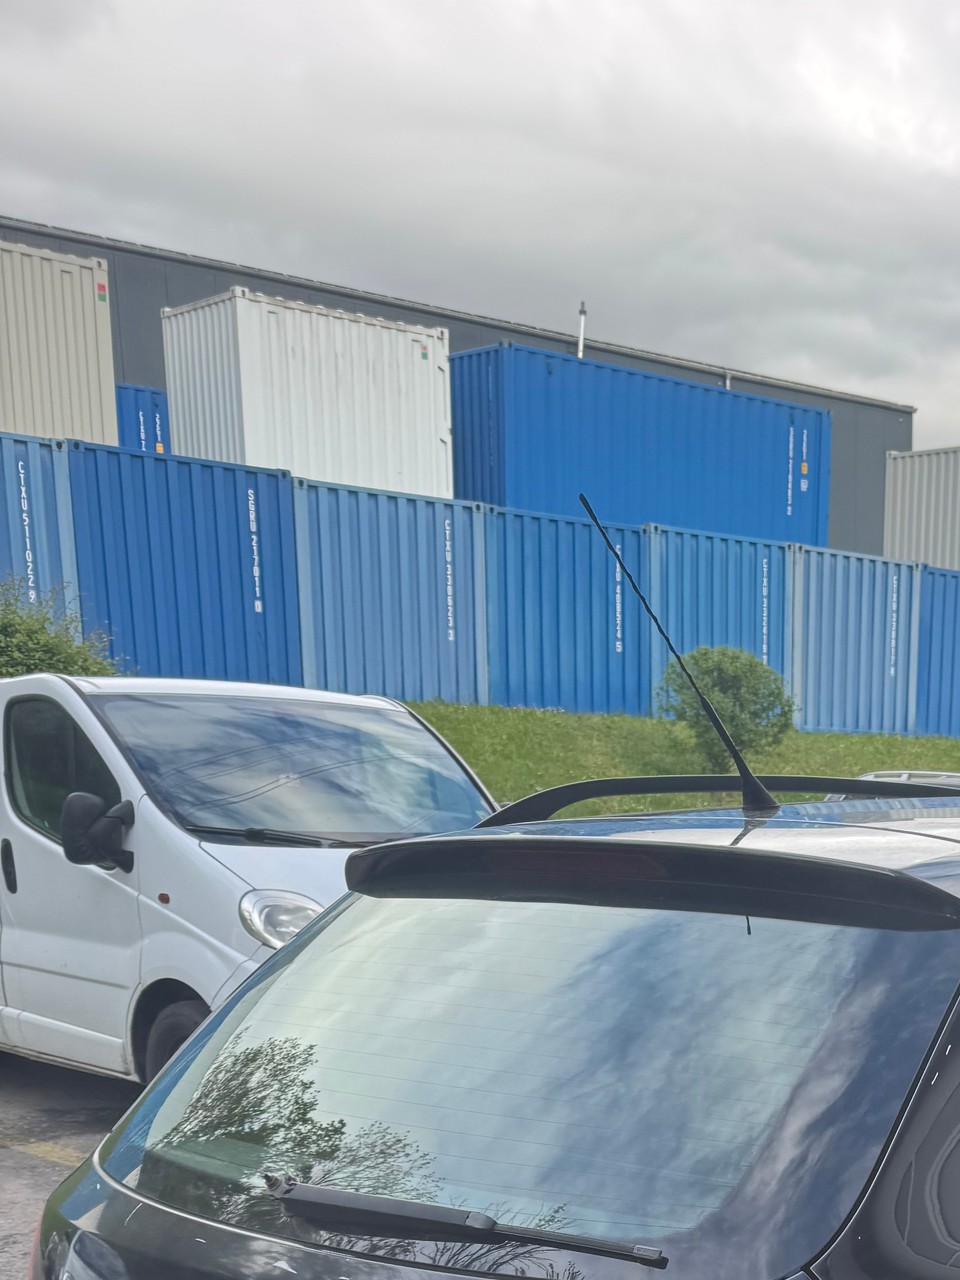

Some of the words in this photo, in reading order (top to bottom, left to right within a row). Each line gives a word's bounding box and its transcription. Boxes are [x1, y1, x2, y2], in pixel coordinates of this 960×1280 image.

[18, 461, 28, 510] CTXU
[247, 489, 257, 532] SGRU
[22, 513, 35, 587] 511022
[444, 519, 452, 562] CTXU
[251, 535, 260, 598] 217011
